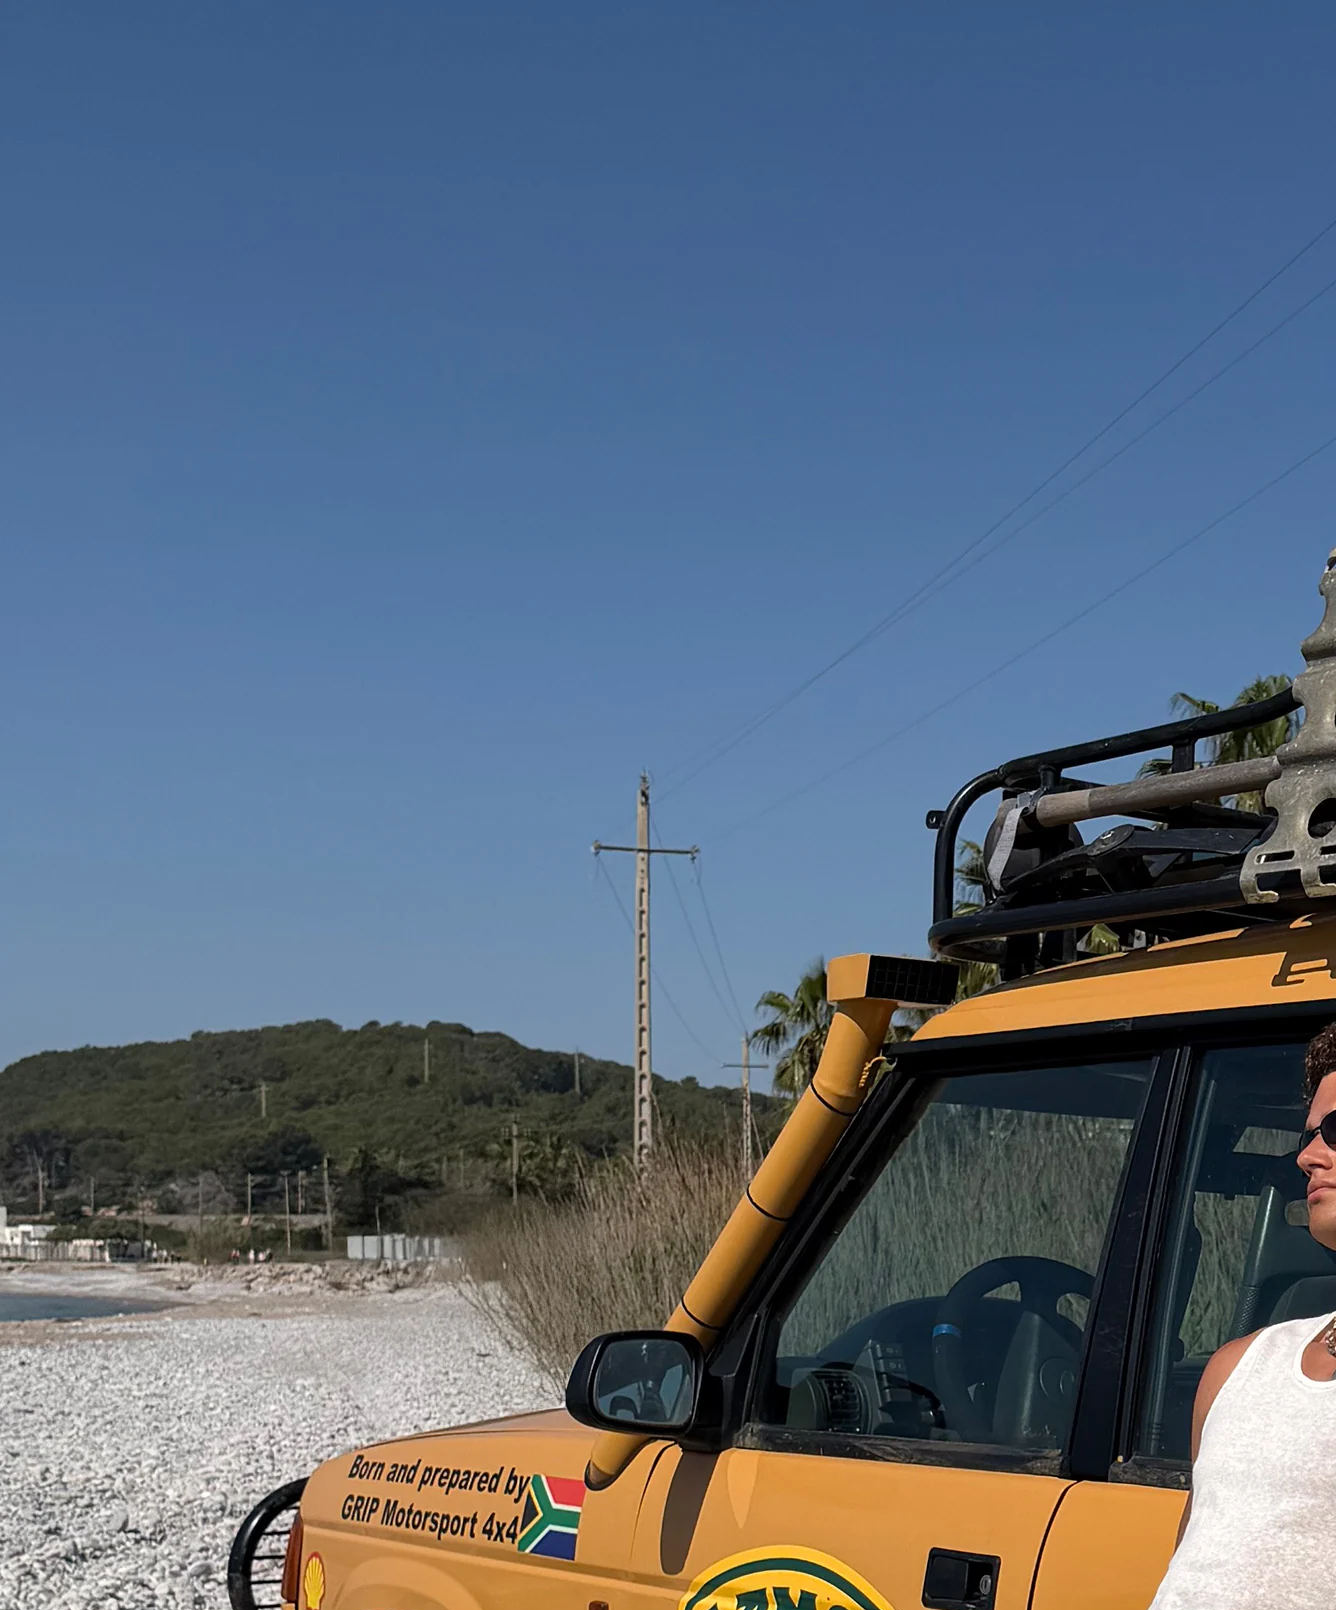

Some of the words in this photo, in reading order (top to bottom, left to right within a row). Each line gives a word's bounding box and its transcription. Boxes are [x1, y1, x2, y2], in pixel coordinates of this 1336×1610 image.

[348, 1454, 386, 1481] Born
[386, 1459, 422, 1484] and
[417, 1466, 505, 1496] prepared
[503, 1467, 532, 1504] by
[341, 1494, 380, 1523] GRIP
[380, 1499, 478, 1541] Motorsport
[482, 1512, 520, 1545] 4x4
